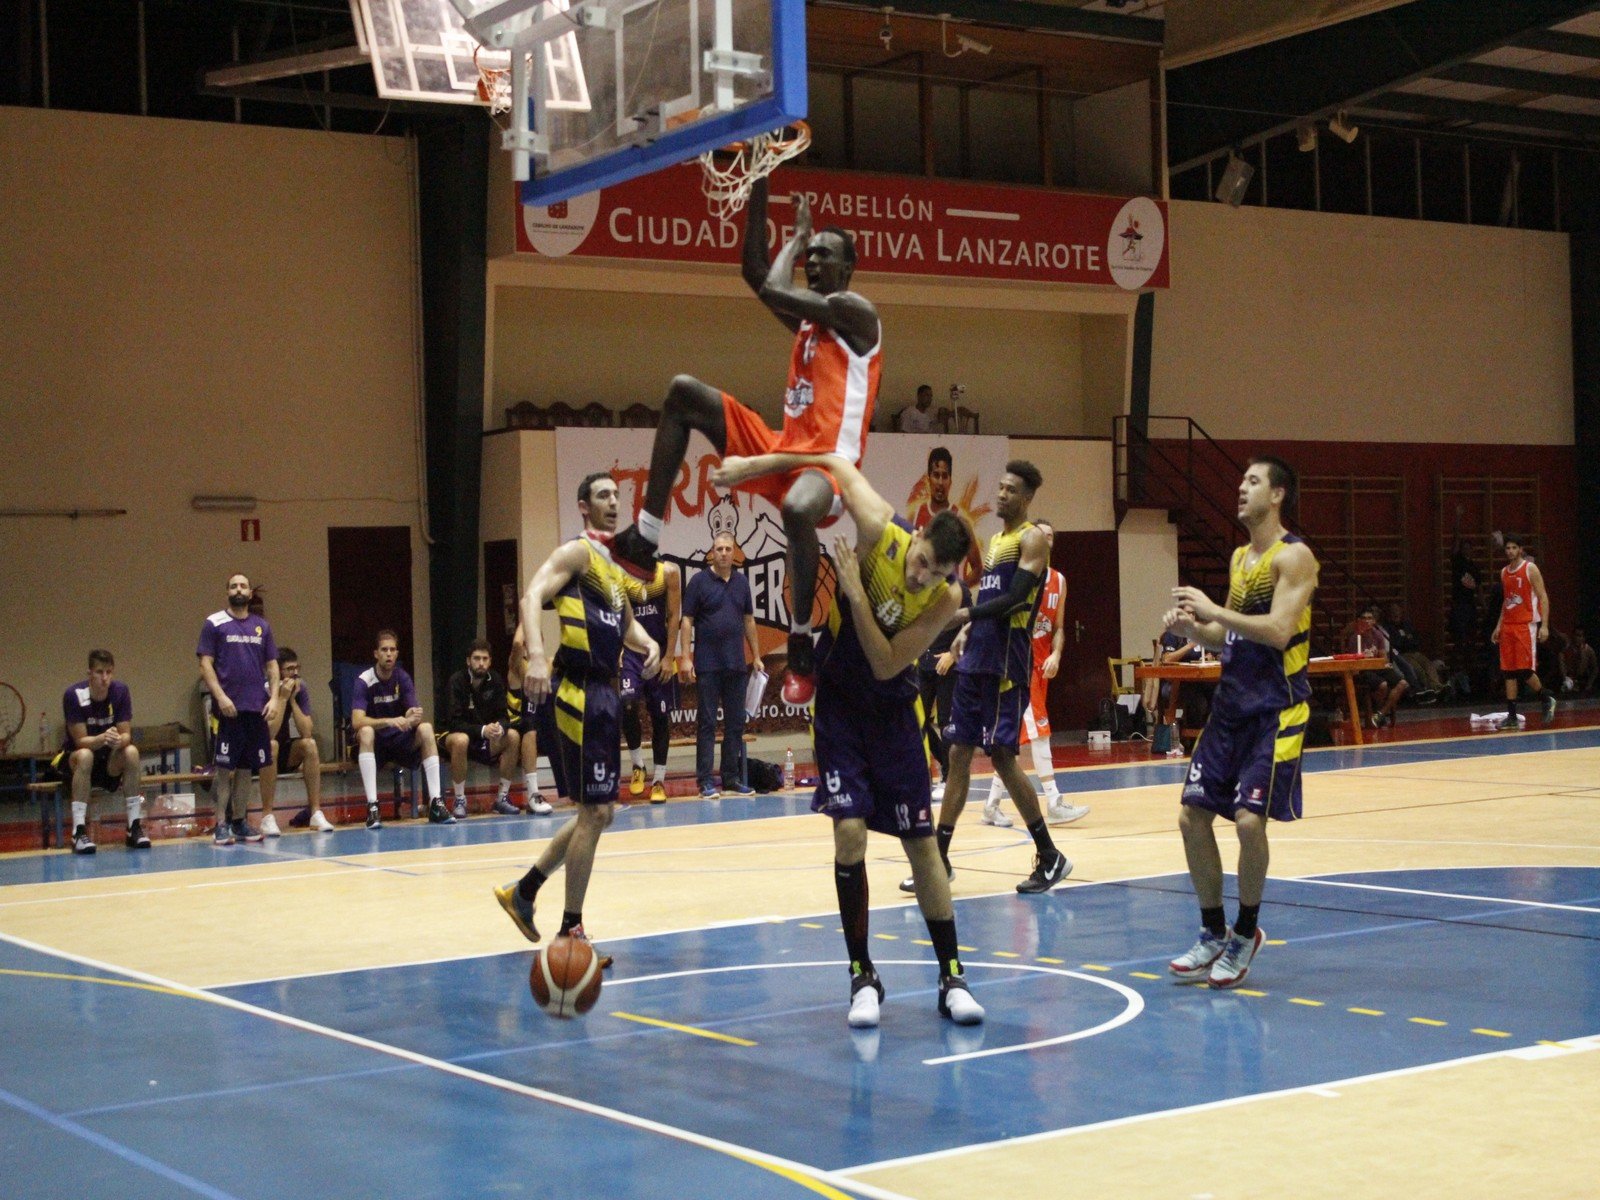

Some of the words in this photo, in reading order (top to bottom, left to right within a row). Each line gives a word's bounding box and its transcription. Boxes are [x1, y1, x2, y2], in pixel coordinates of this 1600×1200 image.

[803, 189, 933, 222] PABELLÓN
[608, 207, 739, 249] CIUDAD
[937, 228, 1101, 271] LANZAROTE
